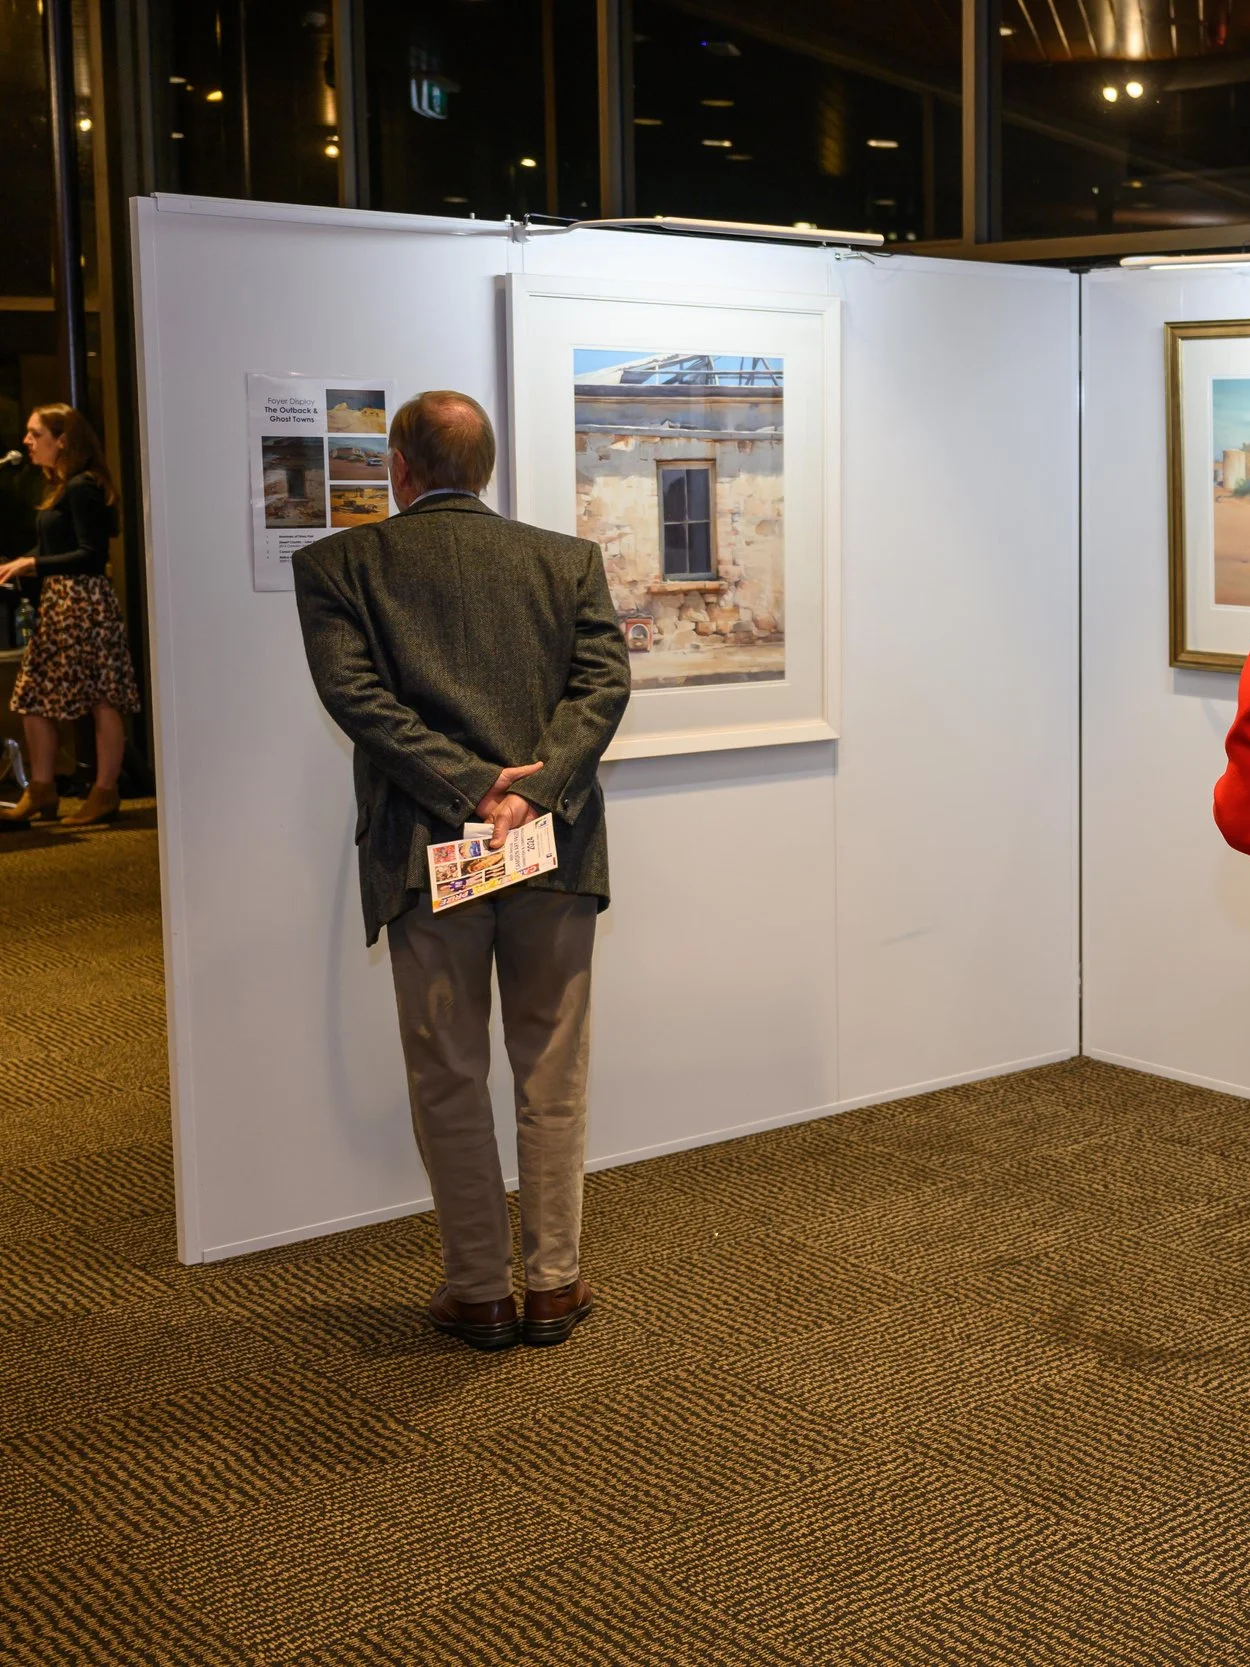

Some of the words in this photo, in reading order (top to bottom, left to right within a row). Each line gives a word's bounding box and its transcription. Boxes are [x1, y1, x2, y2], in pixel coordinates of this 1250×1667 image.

[267, 397, 288, 405] Foyer
[289, 398, 316, 406] Display
[279, 406, 312, 414] Outback
[269, 415, 291, 423] Ghost
